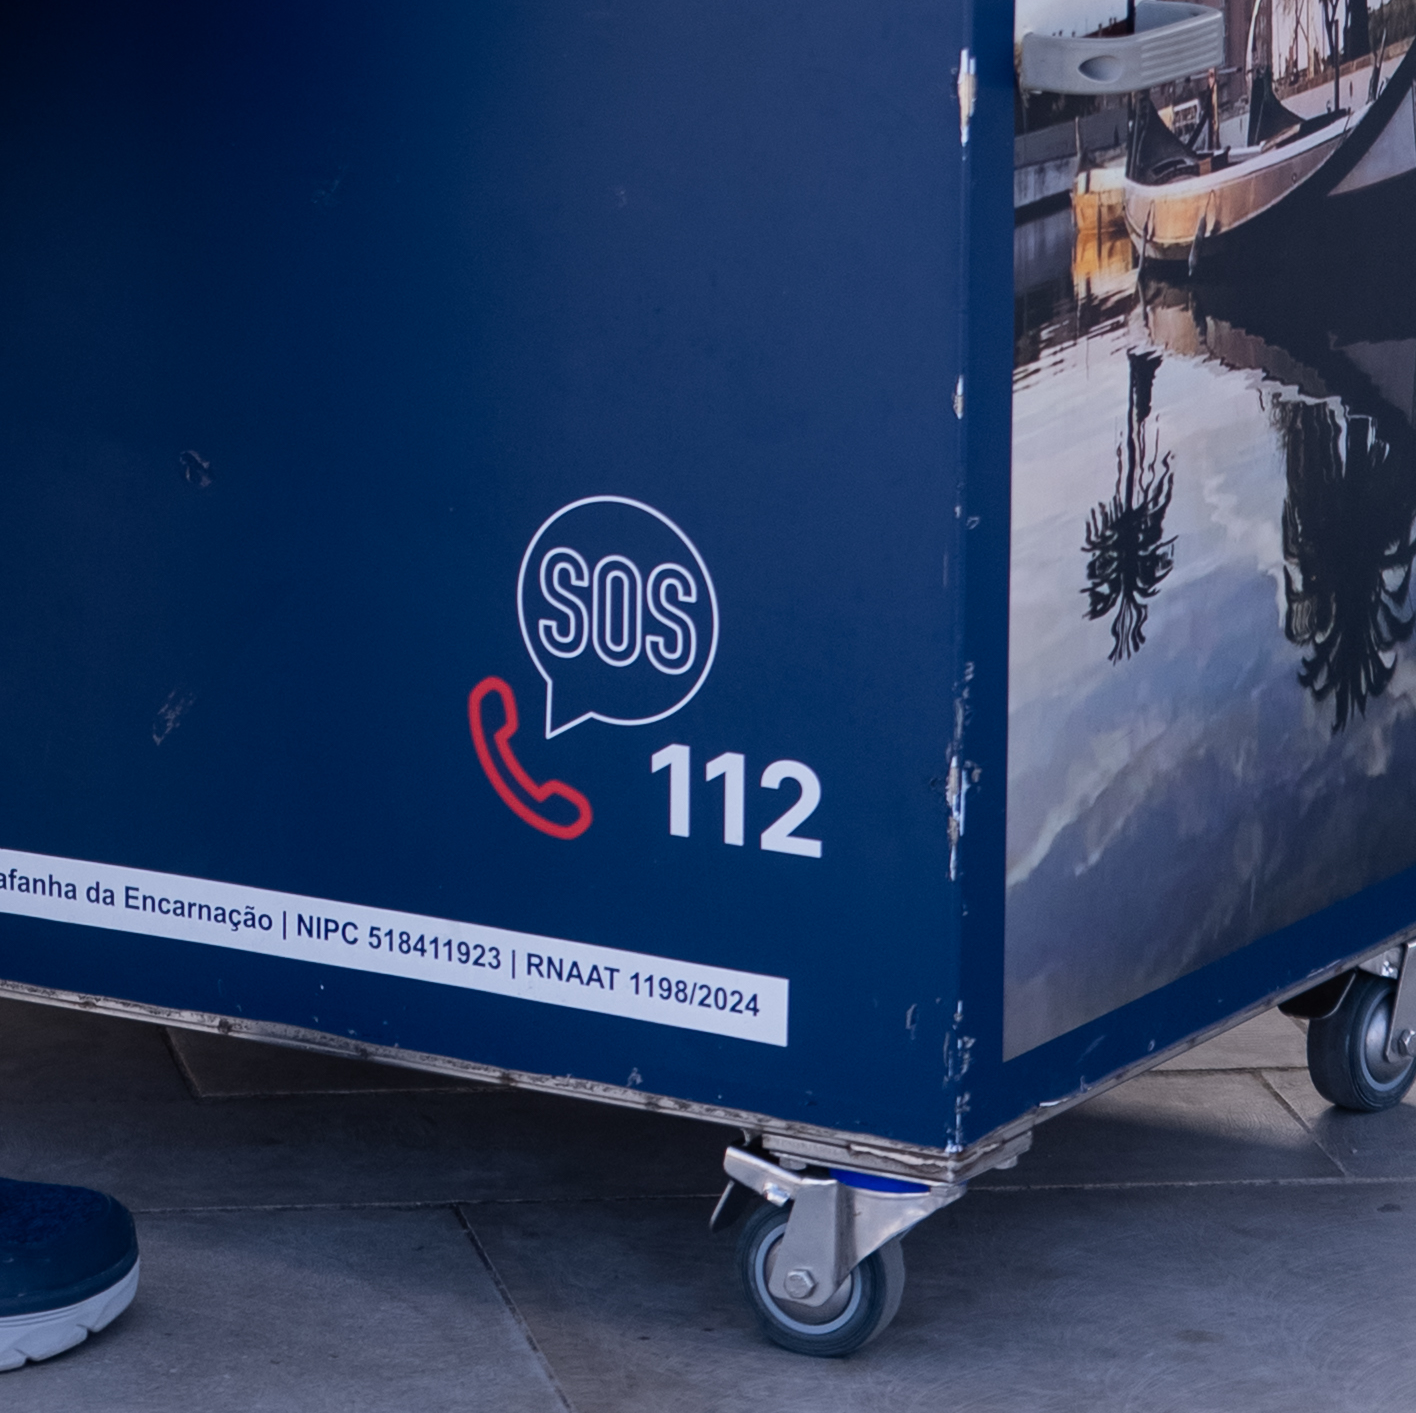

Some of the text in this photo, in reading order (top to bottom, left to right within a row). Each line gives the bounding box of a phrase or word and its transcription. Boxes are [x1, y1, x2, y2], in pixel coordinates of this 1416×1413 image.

[538, 546, 698, 675] SOS
[651, 743, 822, 859] 112
[86, 881, 115, 907] da
[124, 885, 273, 932] Encarnação
[297, 913, 359, 946] NIPC
[368, 926, 502, 970] 518411923
[526, 953, 620, 991] RNAAT
[629, 972, 761, 1018] 1198/2024
